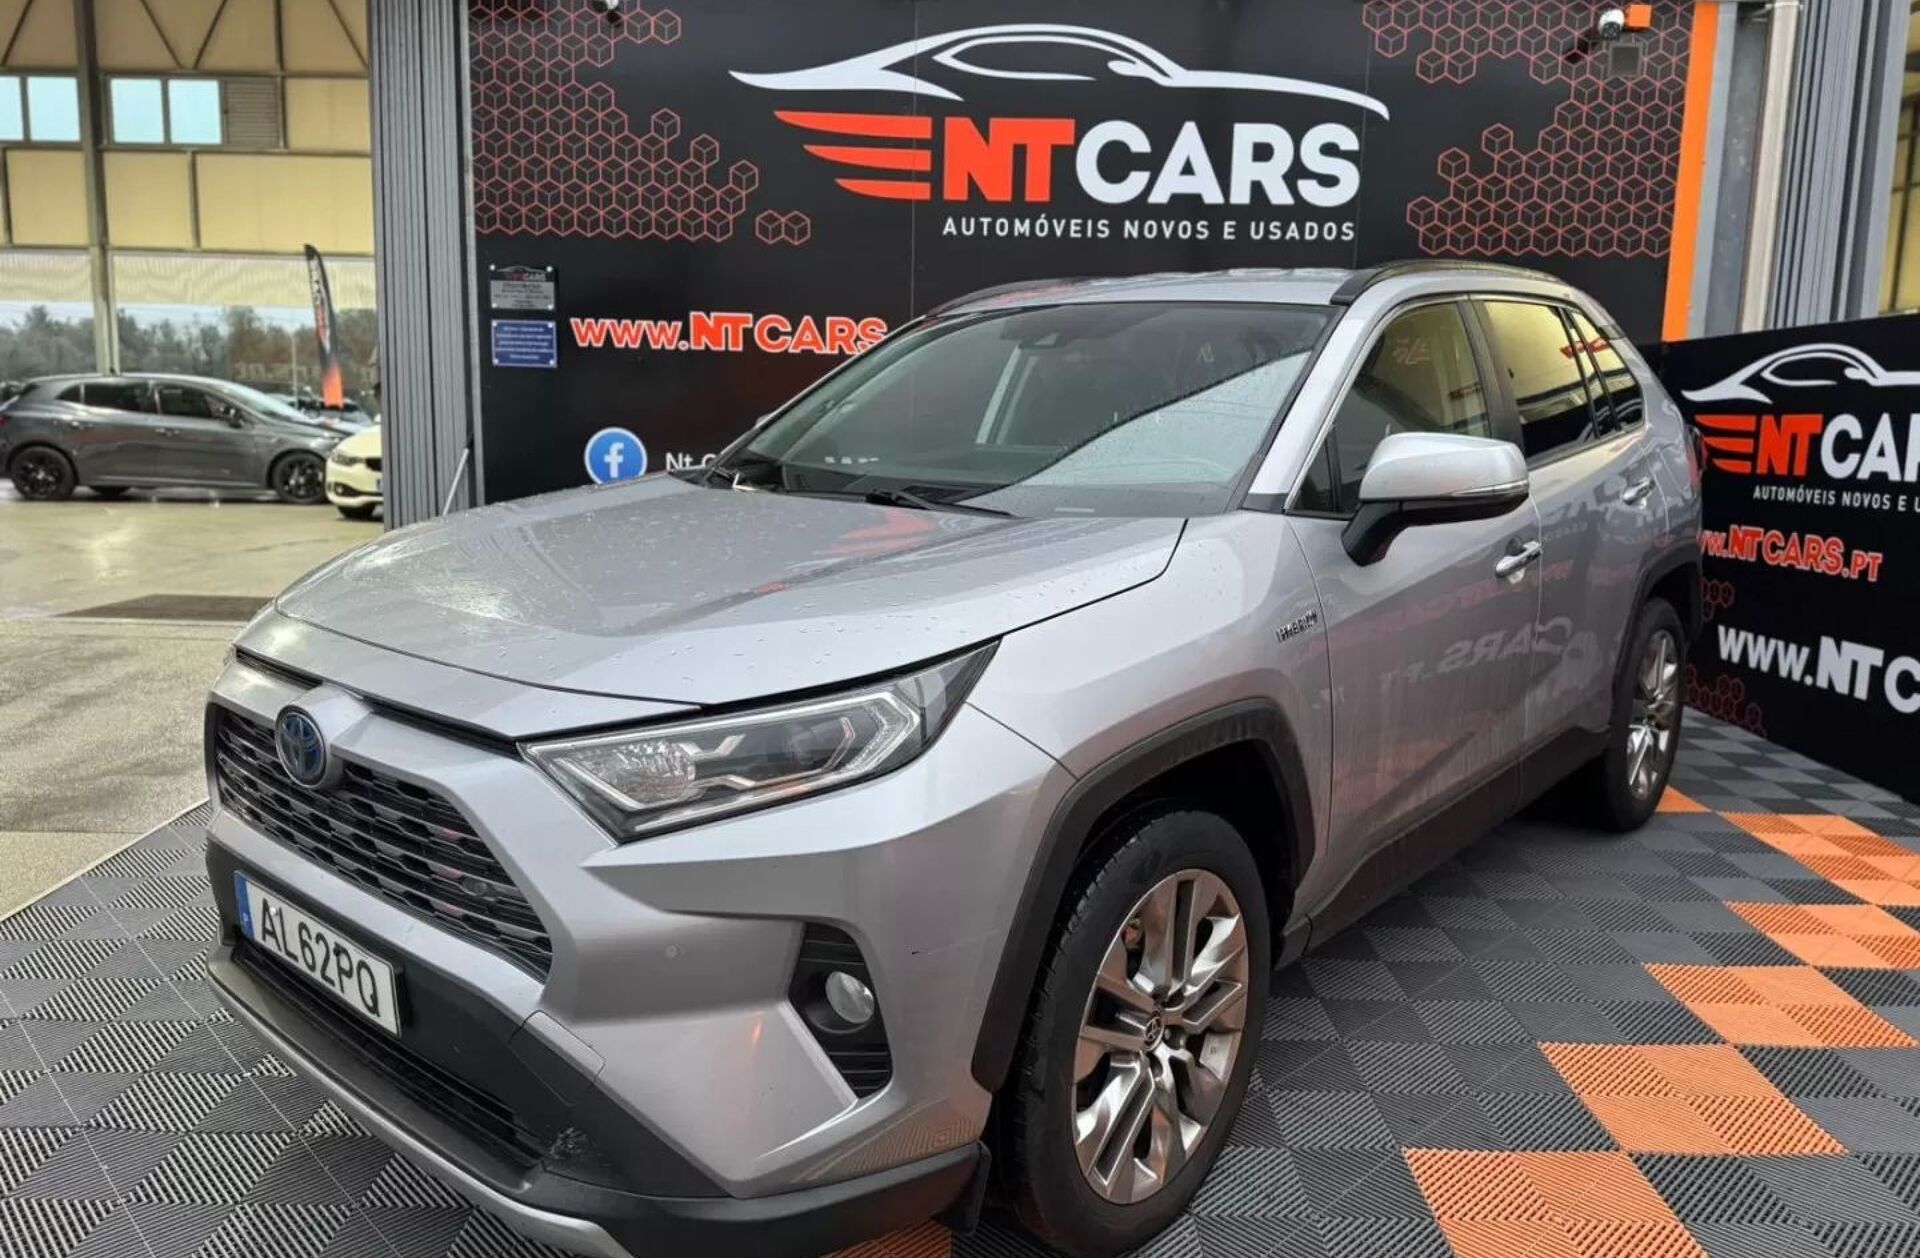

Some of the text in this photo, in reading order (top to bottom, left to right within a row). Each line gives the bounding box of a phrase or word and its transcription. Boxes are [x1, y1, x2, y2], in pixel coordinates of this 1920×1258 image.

[943, 214, 1356, 241] AUTOMÓVEIS NOVOS E USADOS
[1753, 484, 1836, 506] AUTOMÓVEIS
[1841, 492, 1891, 510] NOVOS
[1897, 494, 1907, 512] E
[262, 897, 381, 1018] AL62PQ
